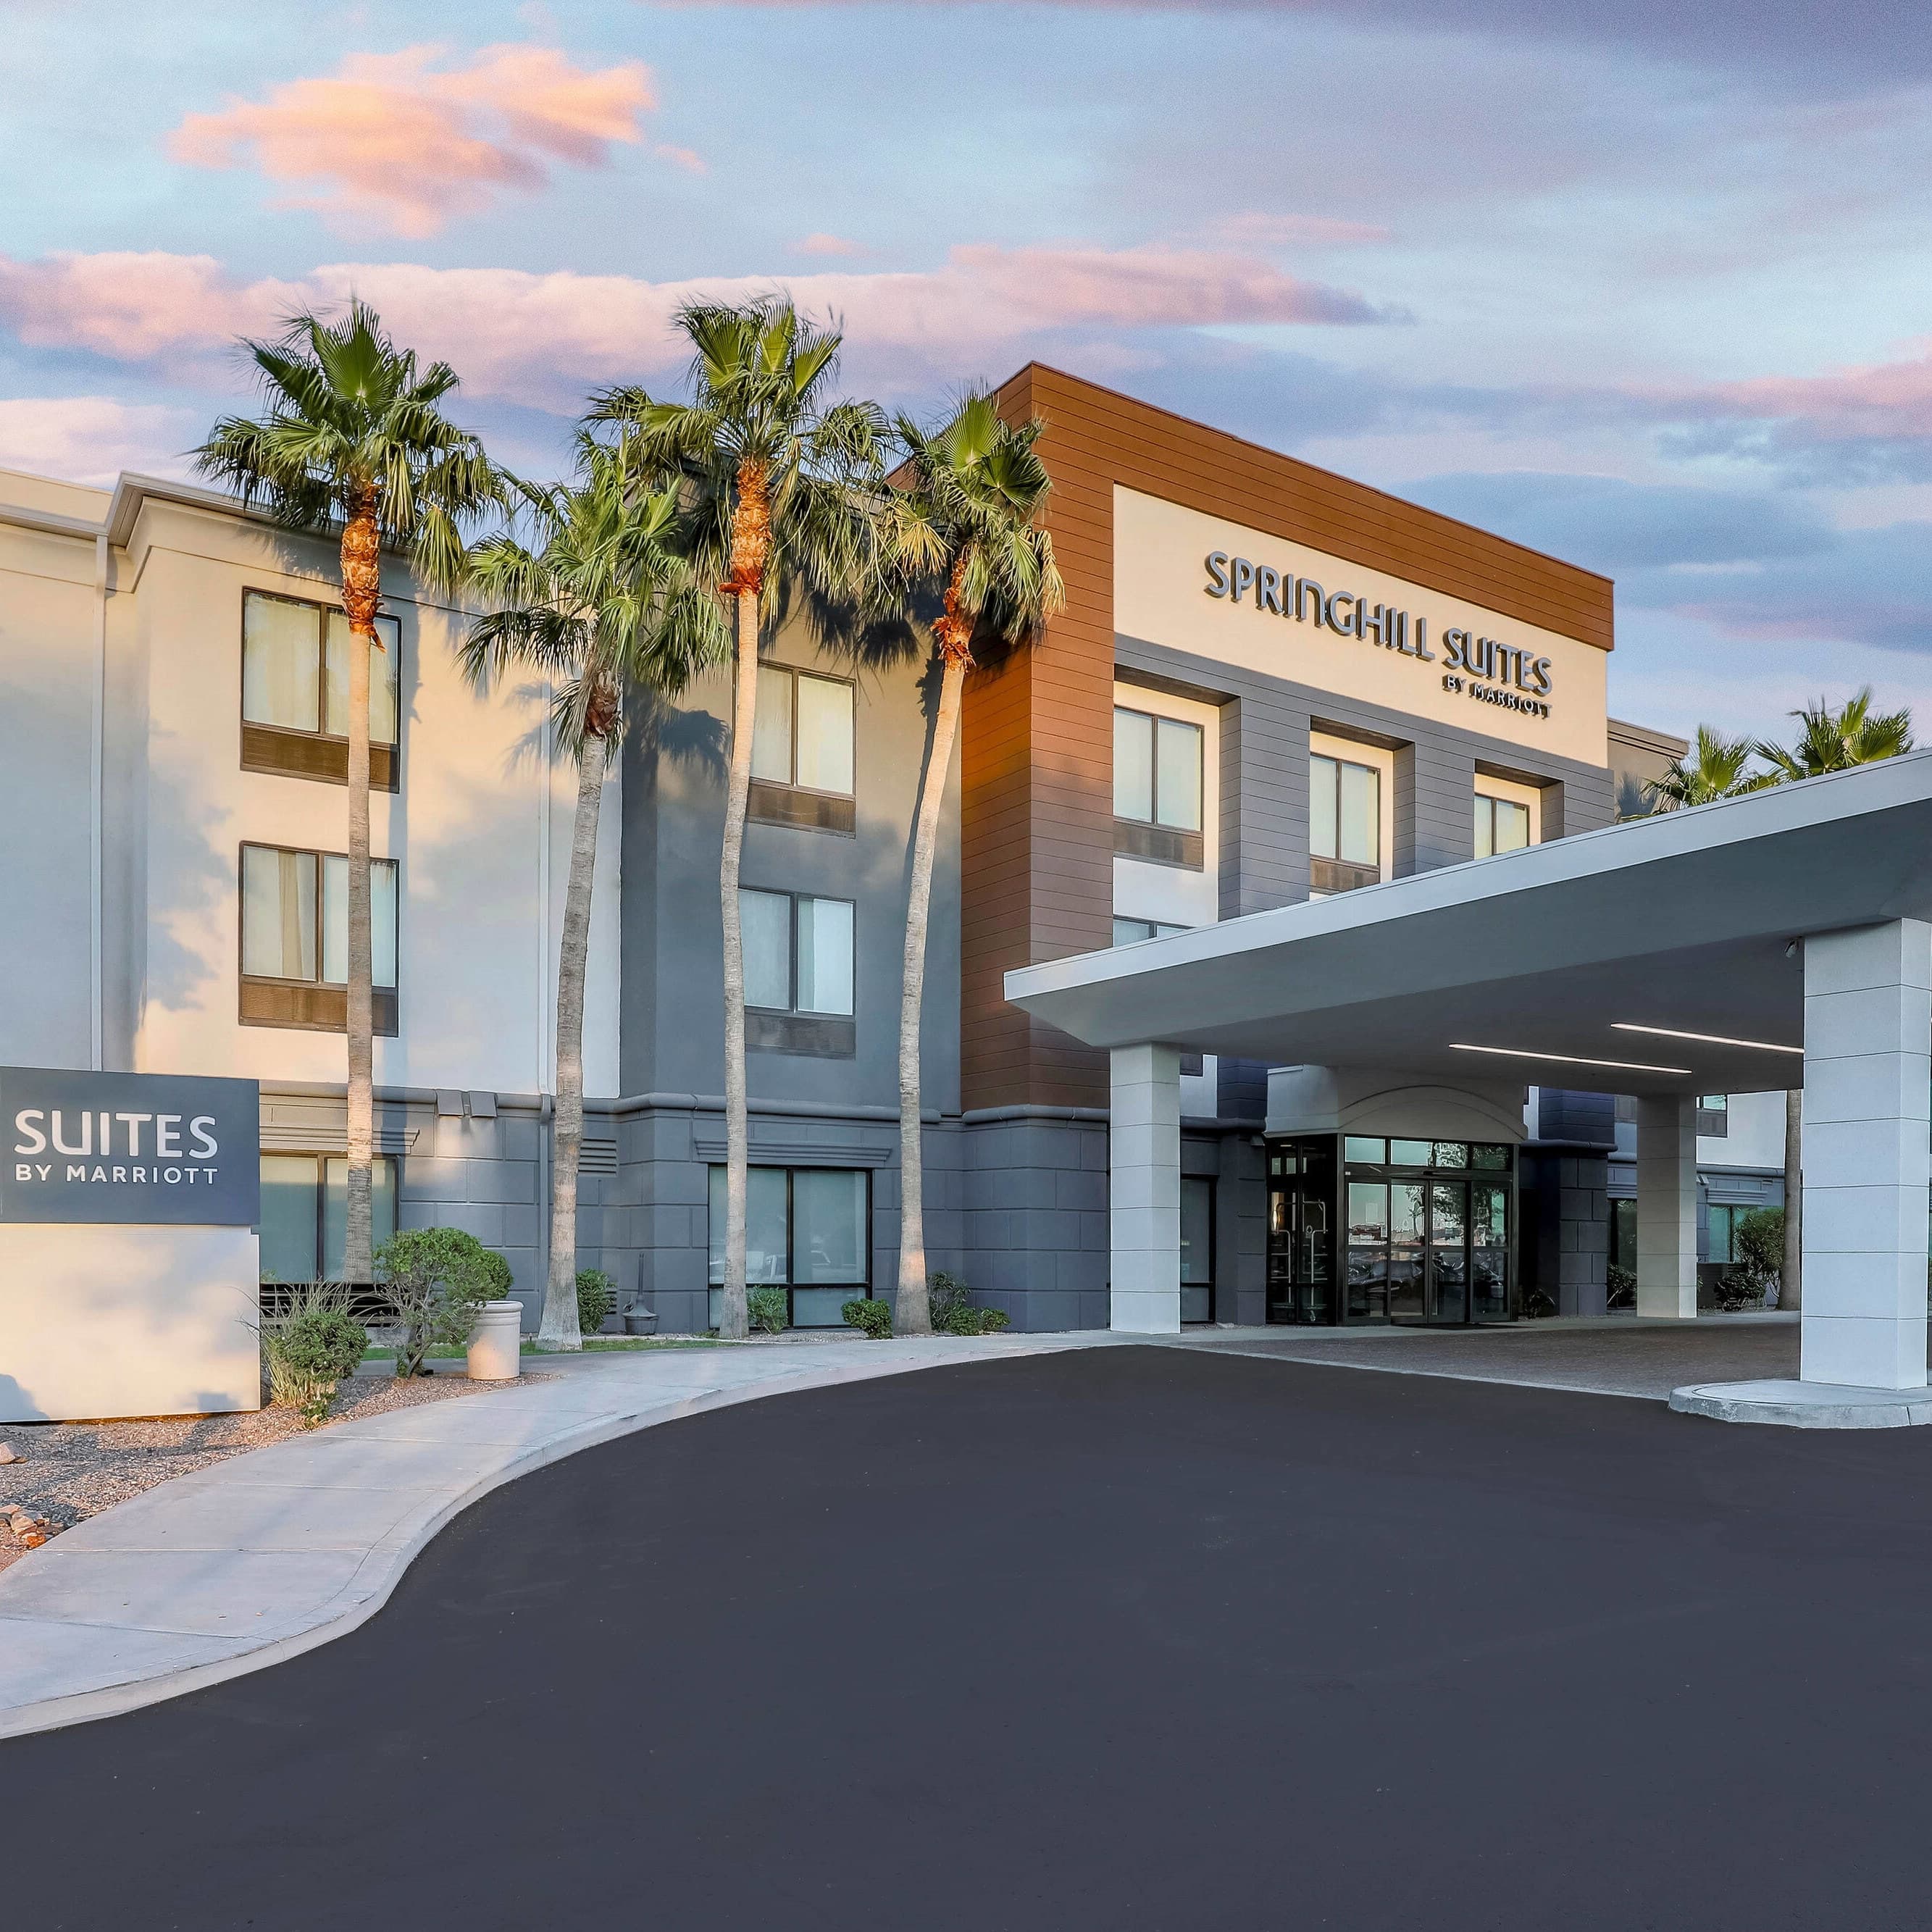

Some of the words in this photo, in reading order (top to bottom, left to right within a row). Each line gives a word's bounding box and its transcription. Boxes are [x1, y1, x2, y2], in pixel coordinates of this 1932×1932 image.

[1204, 551, 1435, 661] SPRINGHILL
[1442, 627, 1552, 696] SUITES
[1444, 674, 1466, 693] BY
[1471, 682, 1552, 718] MARRIOTT
[14, 1109, 218, 1159] SUITES
[15, 1163, 52, 1182] BY
[66, 1165, 218, 1184] MARRIOTT
